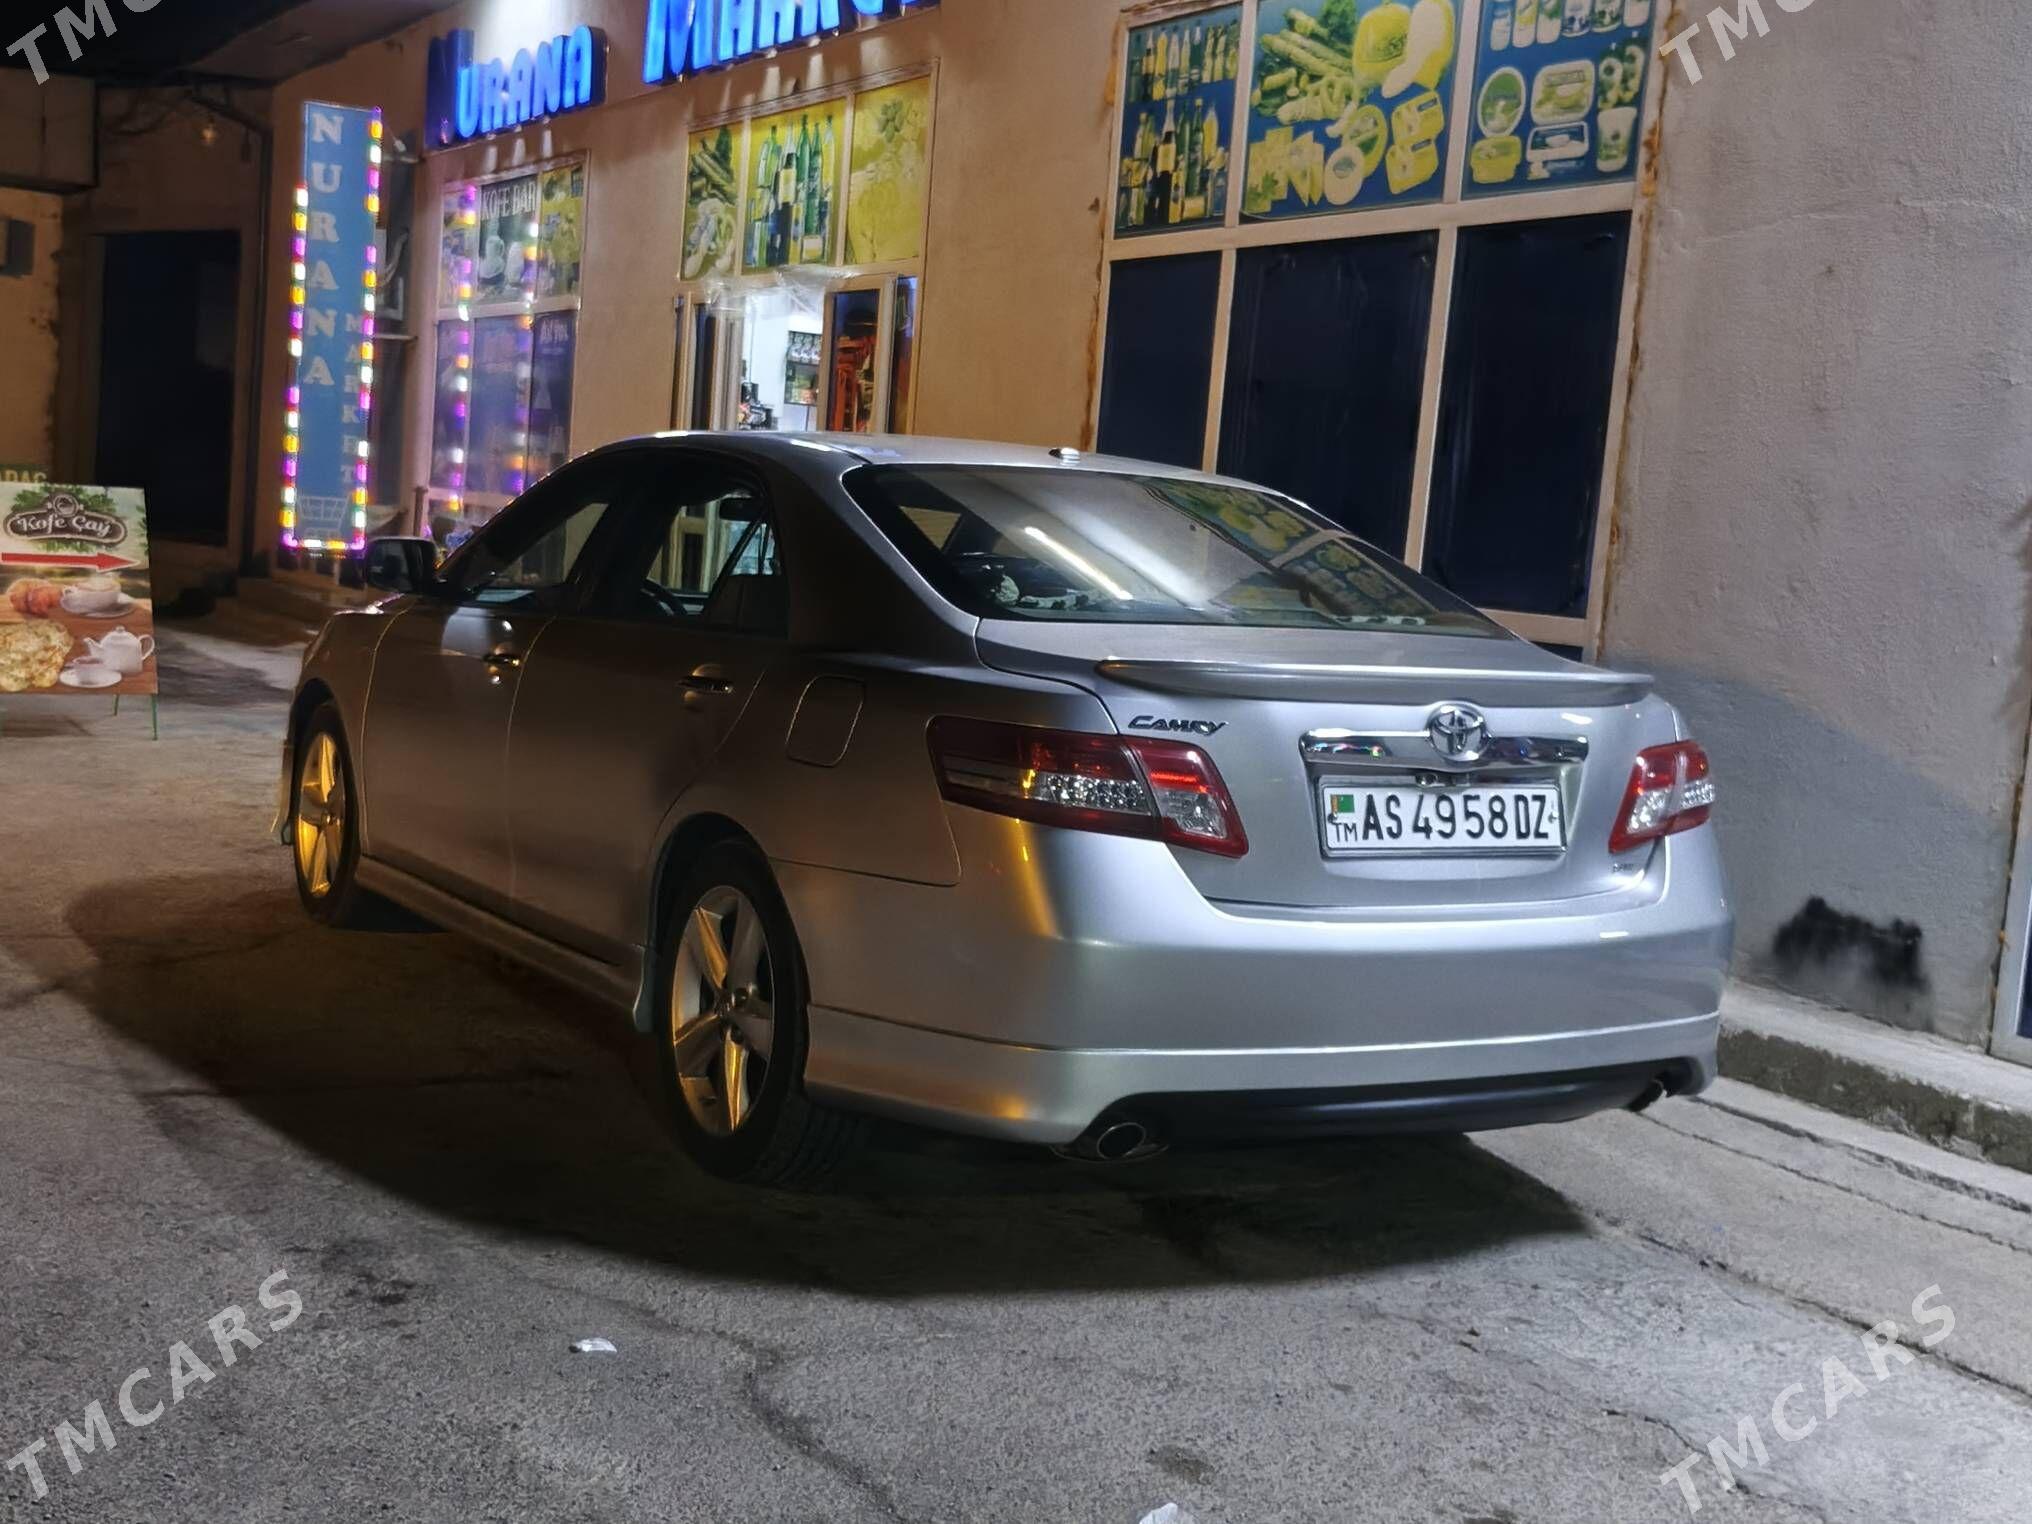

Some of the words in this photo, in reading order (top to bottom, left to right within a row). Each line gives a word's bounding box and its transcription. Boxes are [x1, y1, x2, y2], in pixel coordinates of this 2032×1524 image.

[303, 113, 344, 386] NURANA
[17, 514, 67, 534] Kofe
[1334, 822, 1358, 842] TM
